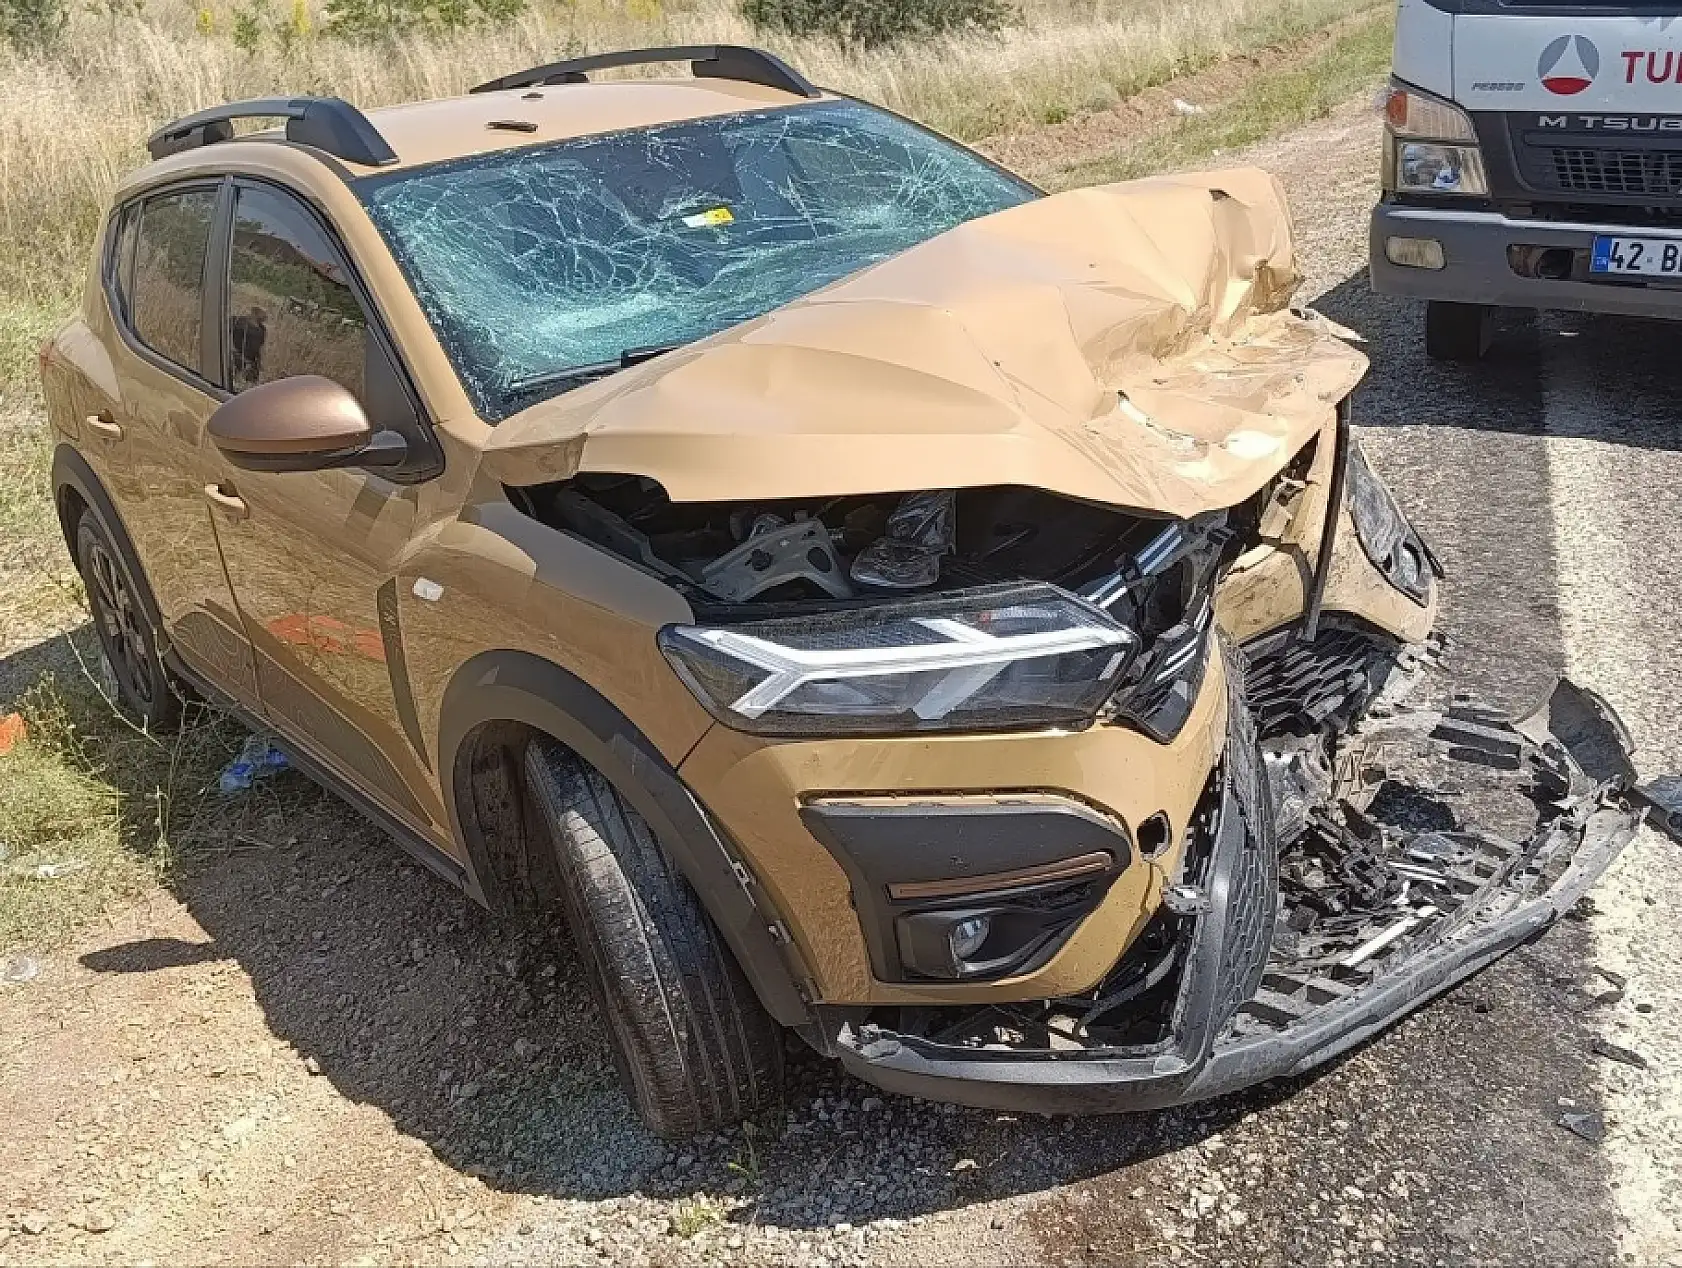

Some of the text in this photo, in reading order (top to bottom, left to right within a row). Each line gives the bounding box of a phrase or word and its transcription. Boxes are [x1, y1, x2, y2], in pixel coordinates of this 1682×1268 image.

[1621, 51, 1682, 84] TU
[1610, 241, 1682, 272] 42 B
